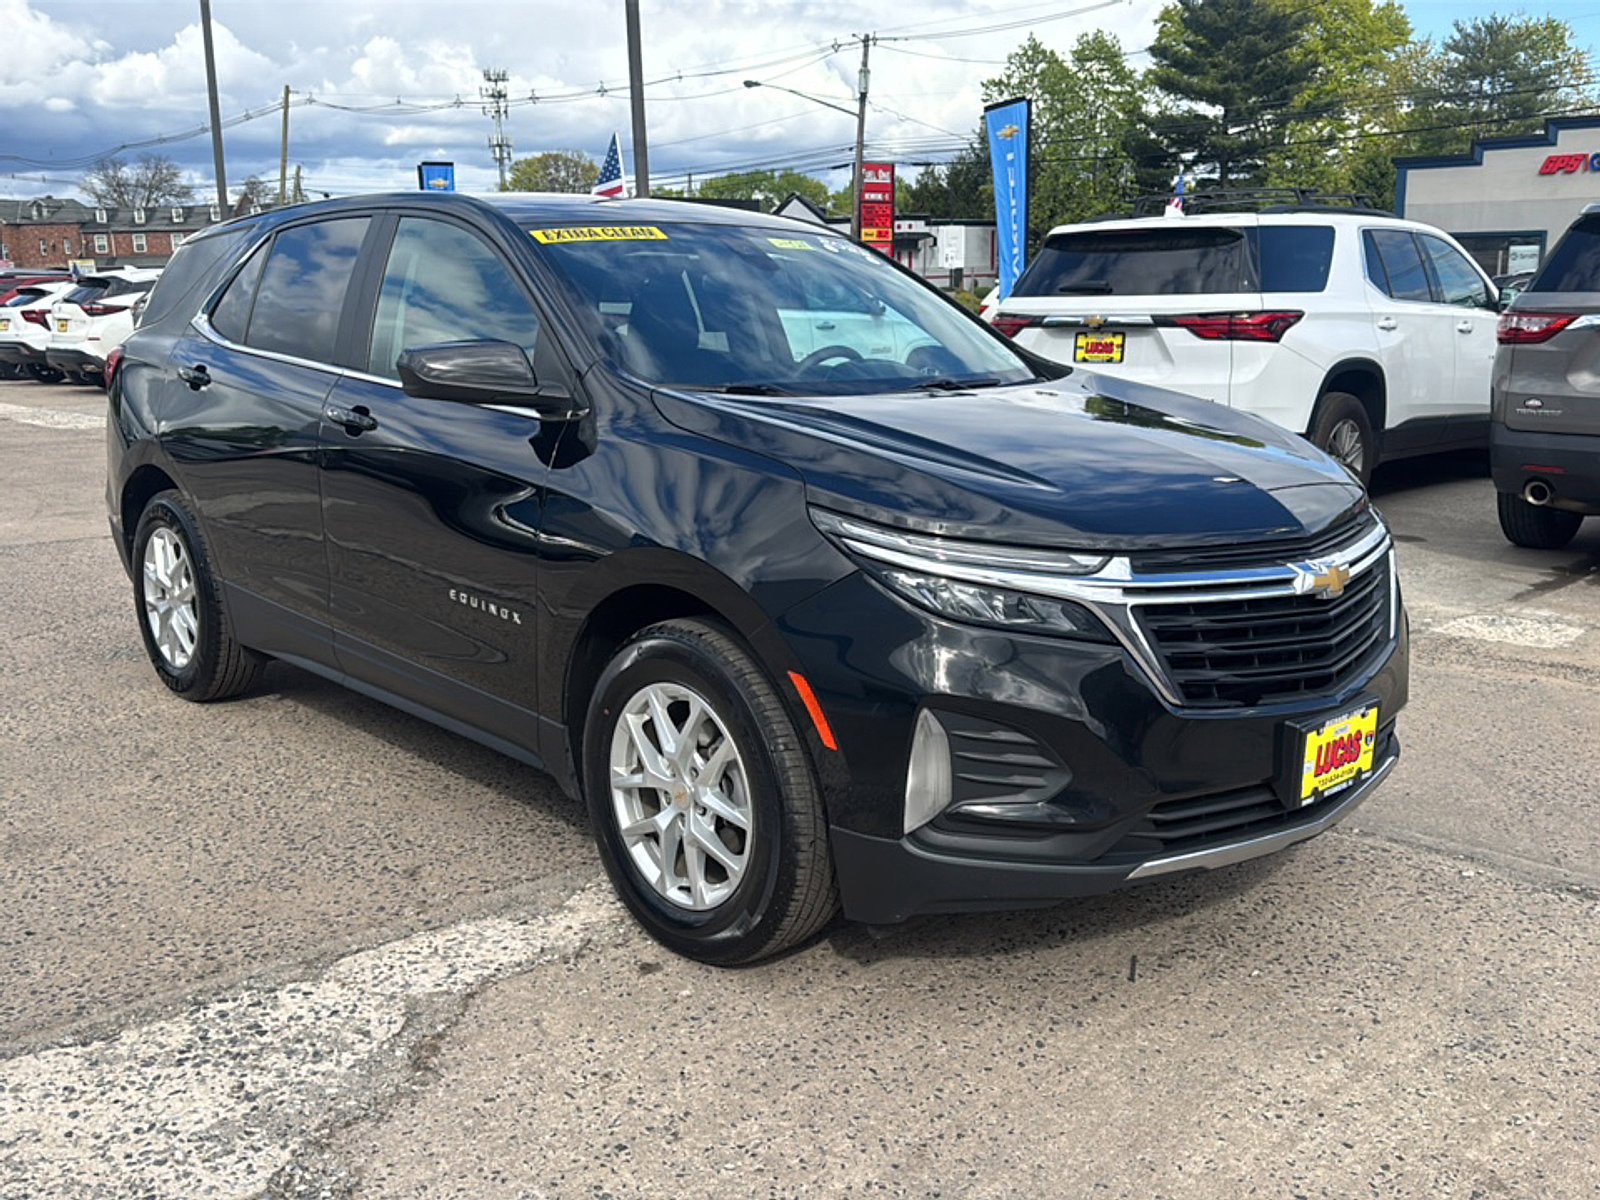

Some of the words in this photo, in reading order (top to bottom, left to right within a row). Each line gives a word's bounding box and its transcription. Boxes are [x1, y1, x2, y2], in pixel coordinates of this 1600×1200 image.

[541, 227, 599, 240] EXTRA
[601, 227, 656, 238] CLEAN
[1085, 341, 1114, 354] LUCAS
[449, 588, 522, 625] EQUINOX
[1314, 729, 1362, 778] LUCAS
